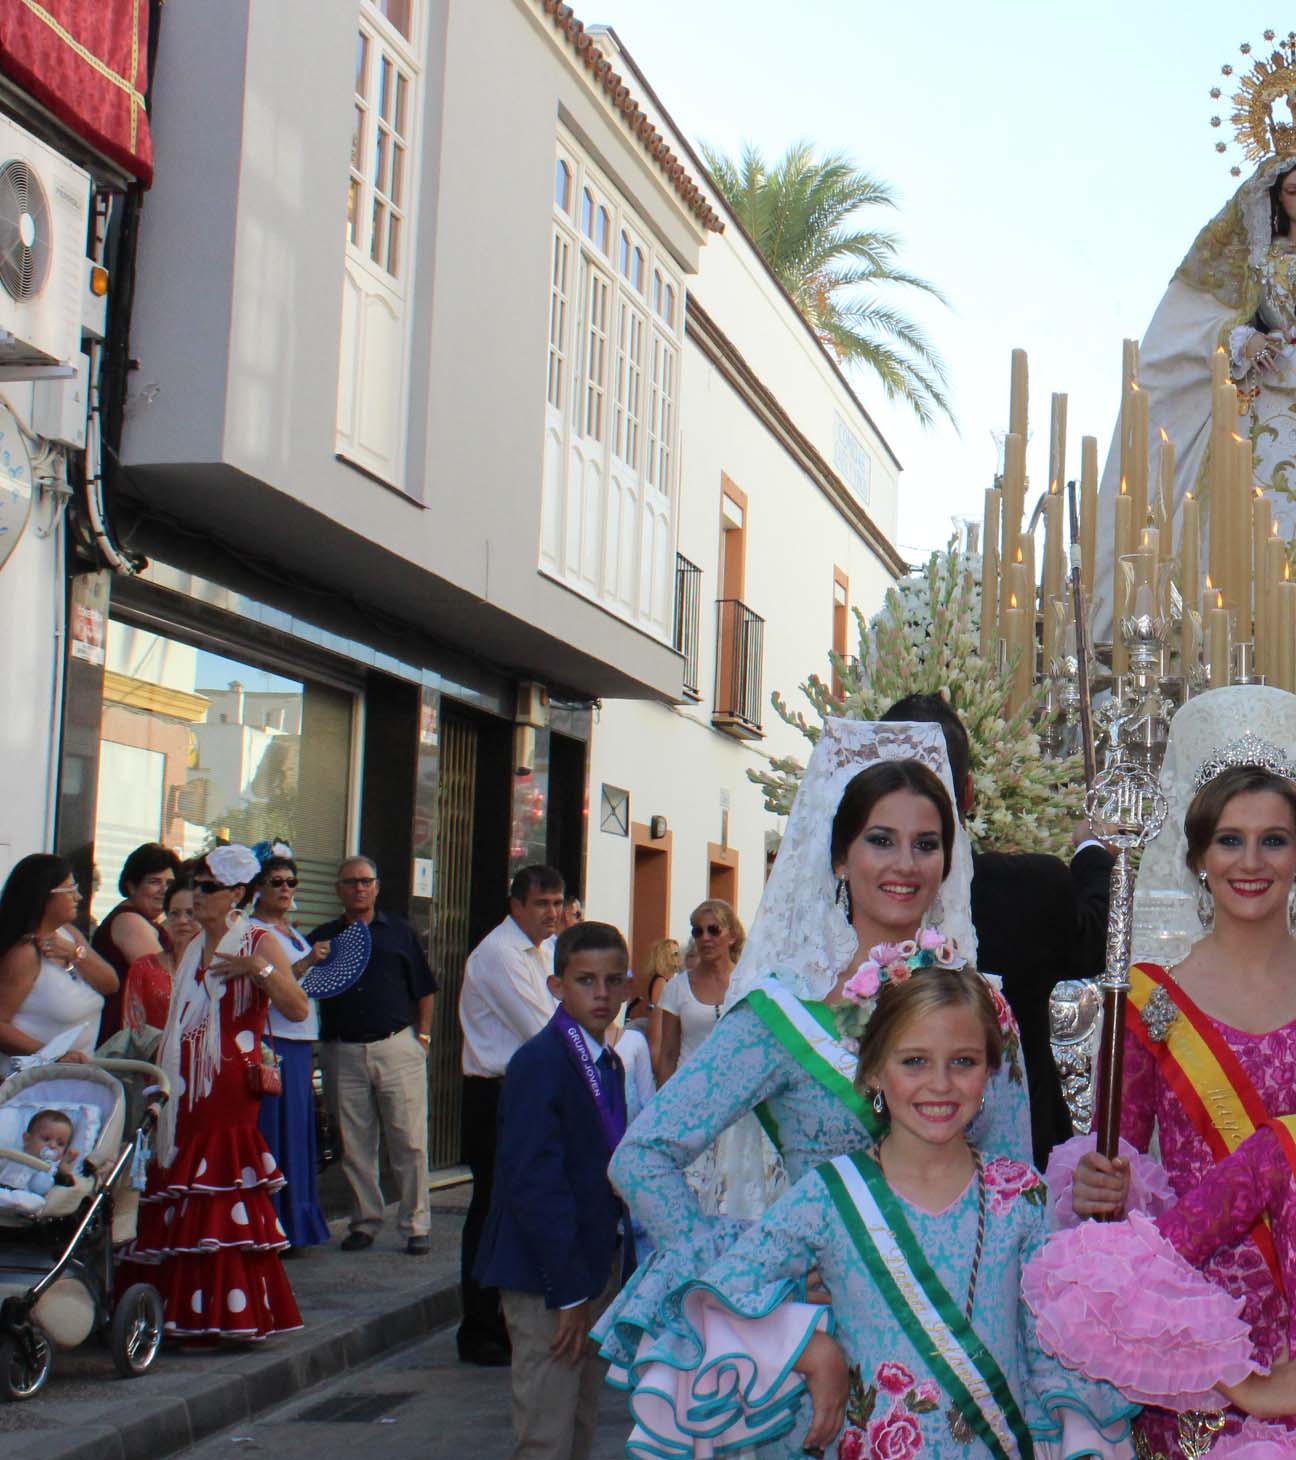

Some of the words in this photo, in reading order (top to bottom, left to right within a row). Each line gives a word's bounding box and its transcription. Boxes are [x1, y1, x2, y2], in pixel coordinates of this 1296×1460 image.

[567, 1027, 589, 1062] GRUPO
[584, 1064, 601, 1096] JOVEN
[884, 1247, 927, 1313] Dama
[923, 1319, 993, 1399] Infantil
